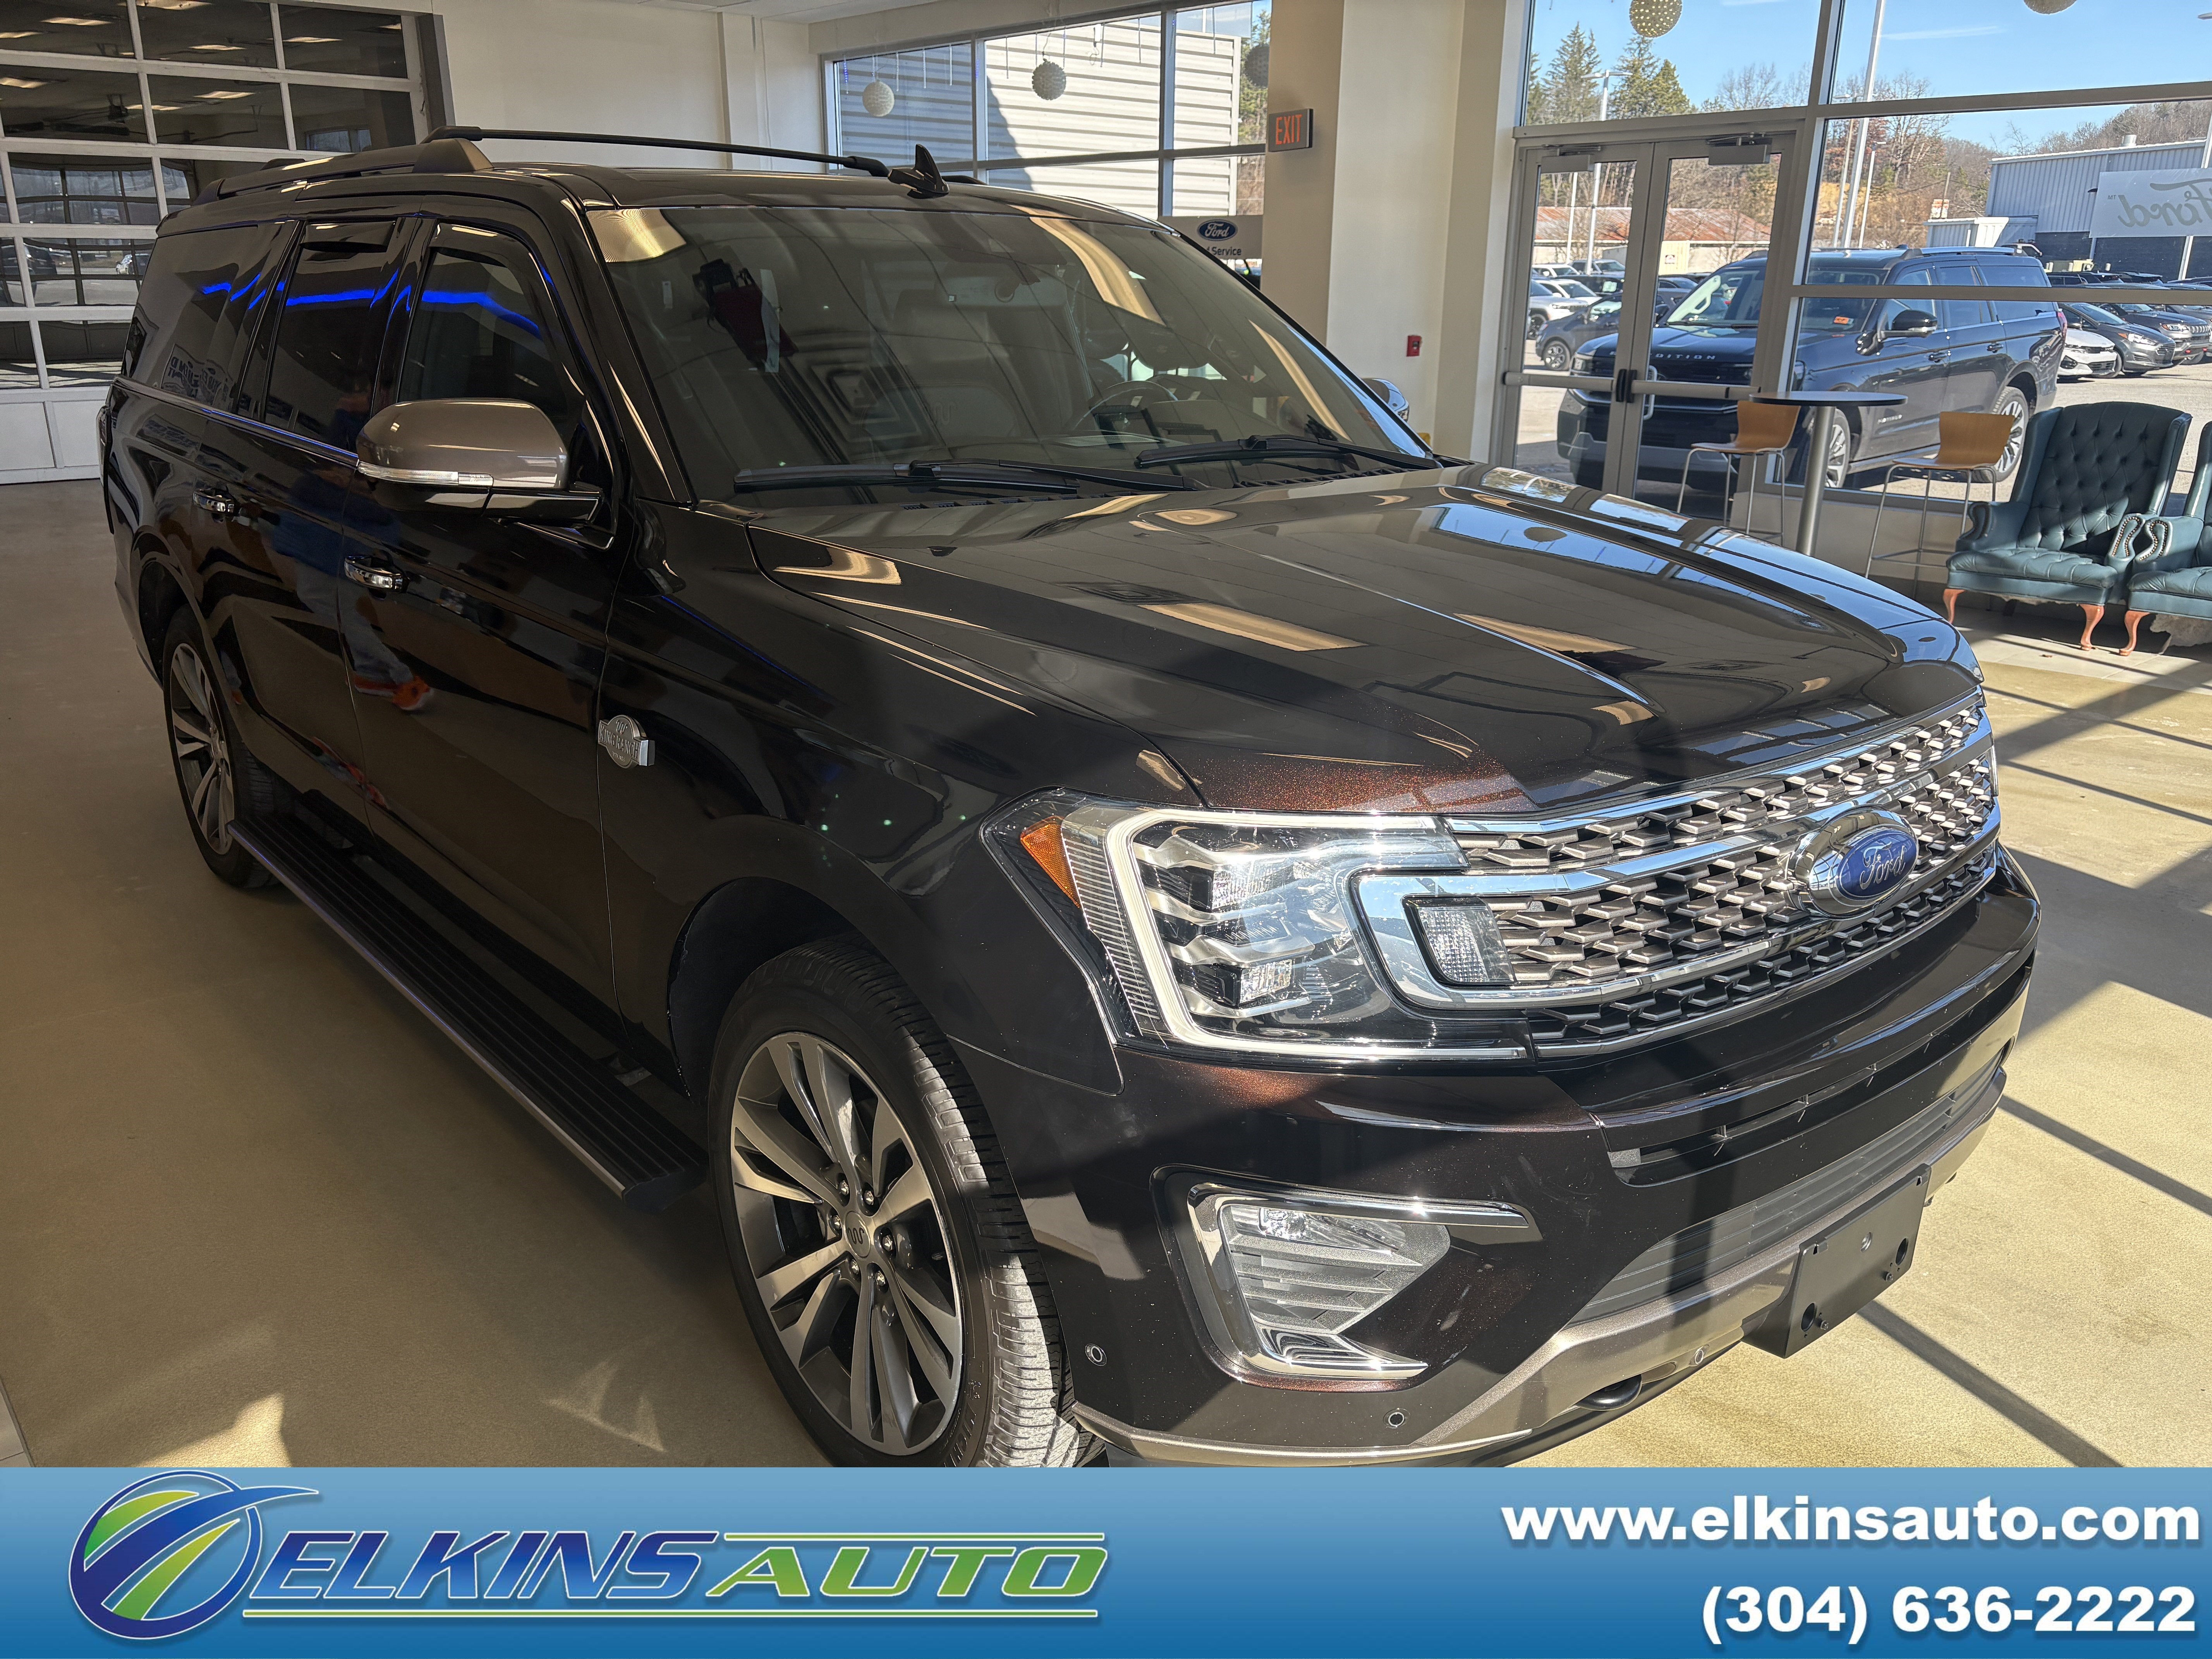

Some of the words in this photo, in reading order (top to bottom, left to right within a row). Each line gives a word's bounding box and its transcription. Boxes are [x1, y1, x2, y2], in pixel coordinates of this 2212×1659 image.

[1276, 114, 1303, 145] EXIT
[1204, 222, 1230, 237] Ford
[1211, 246, 1242, 256] Service
[599, 725, 615, 747] KING
[616, 735, 638, 759] RANCH
[1860, 841, 1906, 890] Ford
